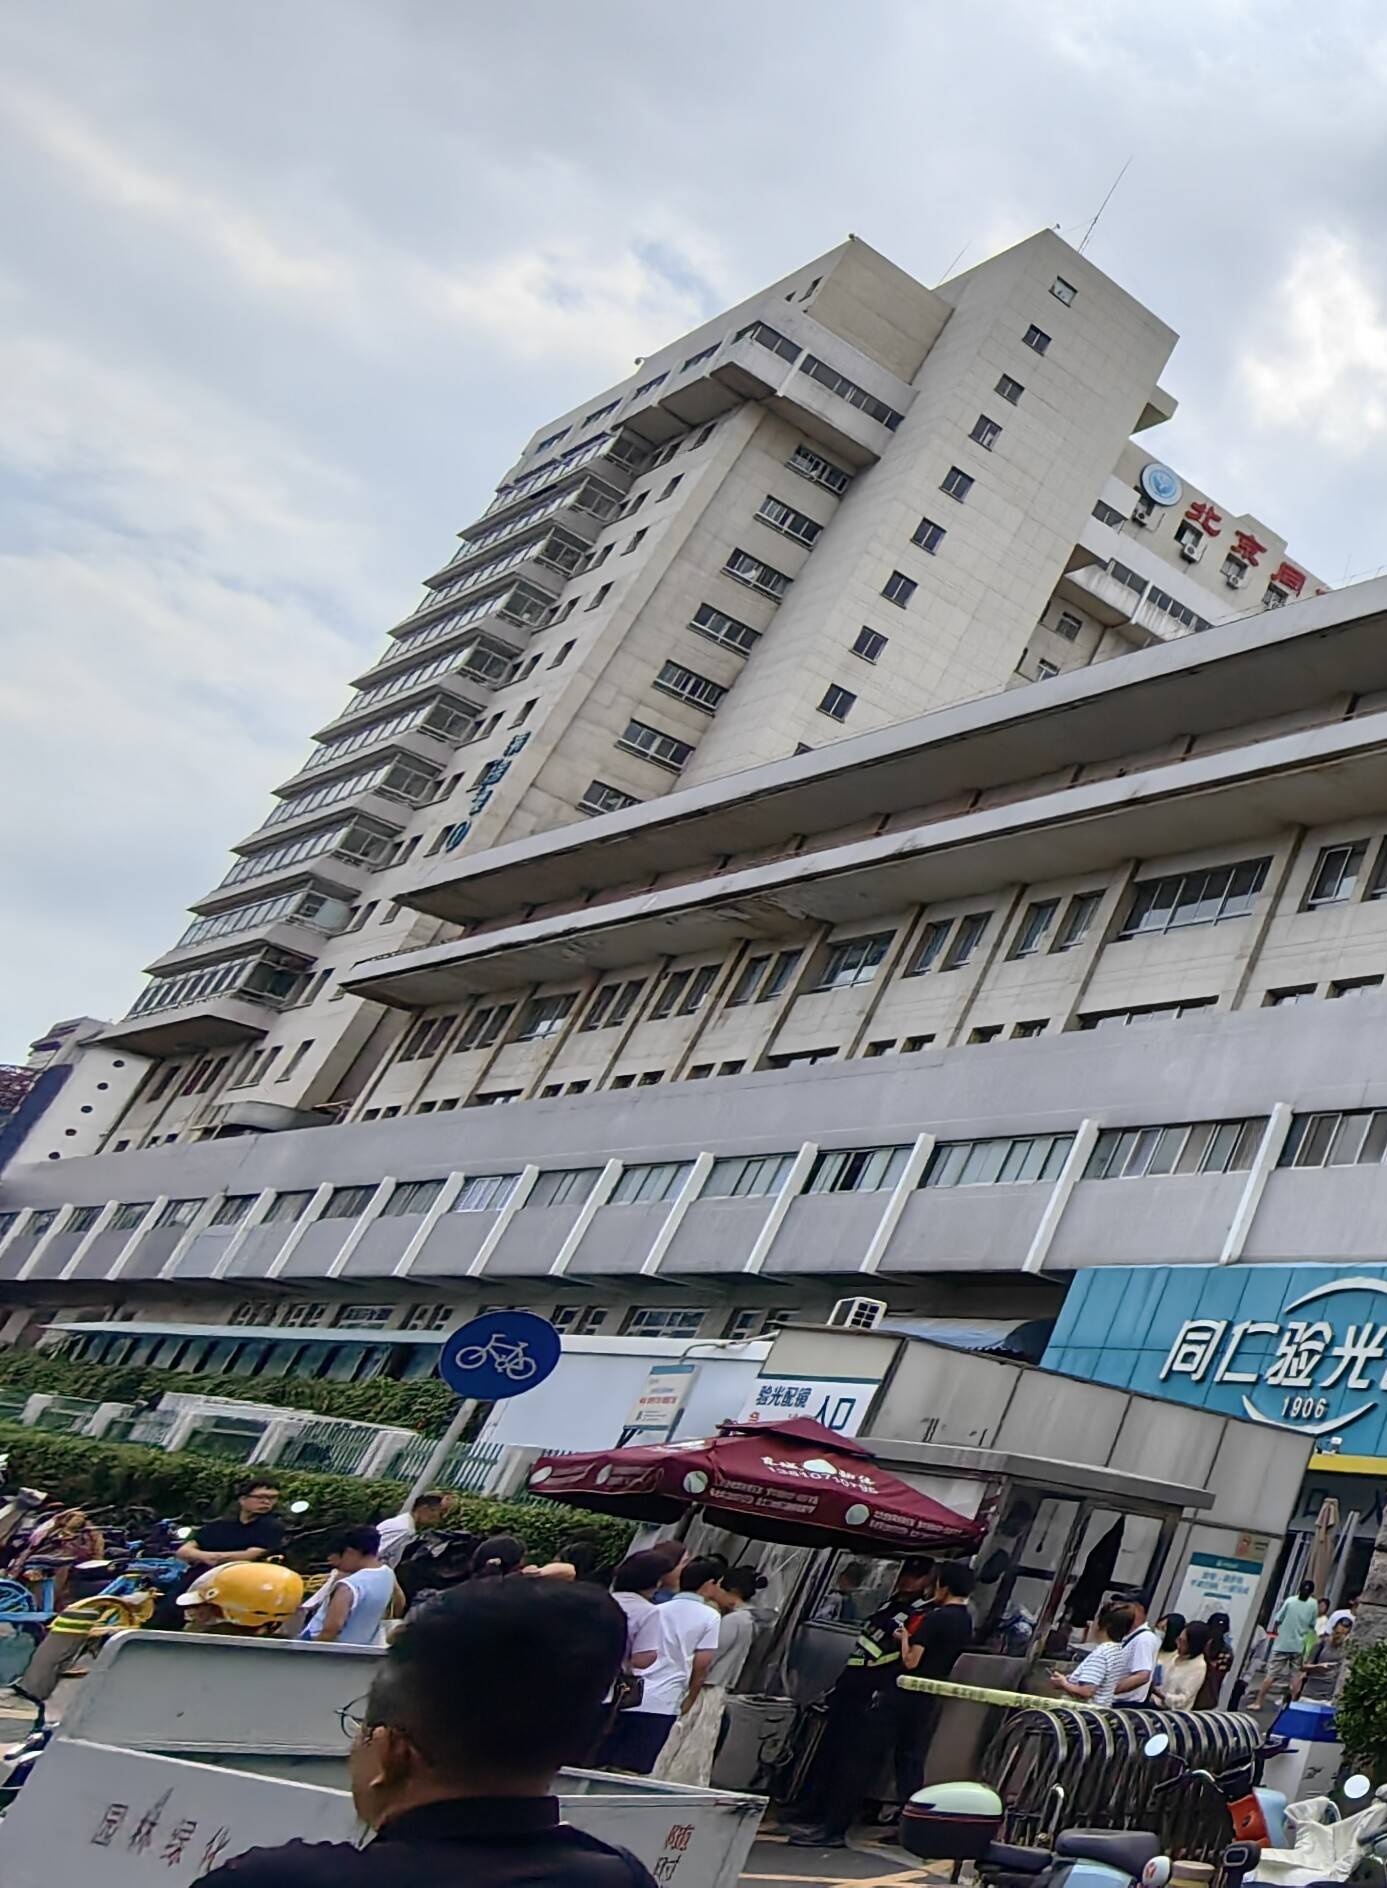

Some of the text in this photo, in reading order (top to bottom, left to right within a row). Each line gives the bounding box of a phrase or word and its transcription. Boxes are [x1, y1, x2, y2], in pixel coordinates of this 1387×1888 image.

[1185, 501, 1329, 598] 北京同
[1280, 1396, 1329, 1420] 1906
